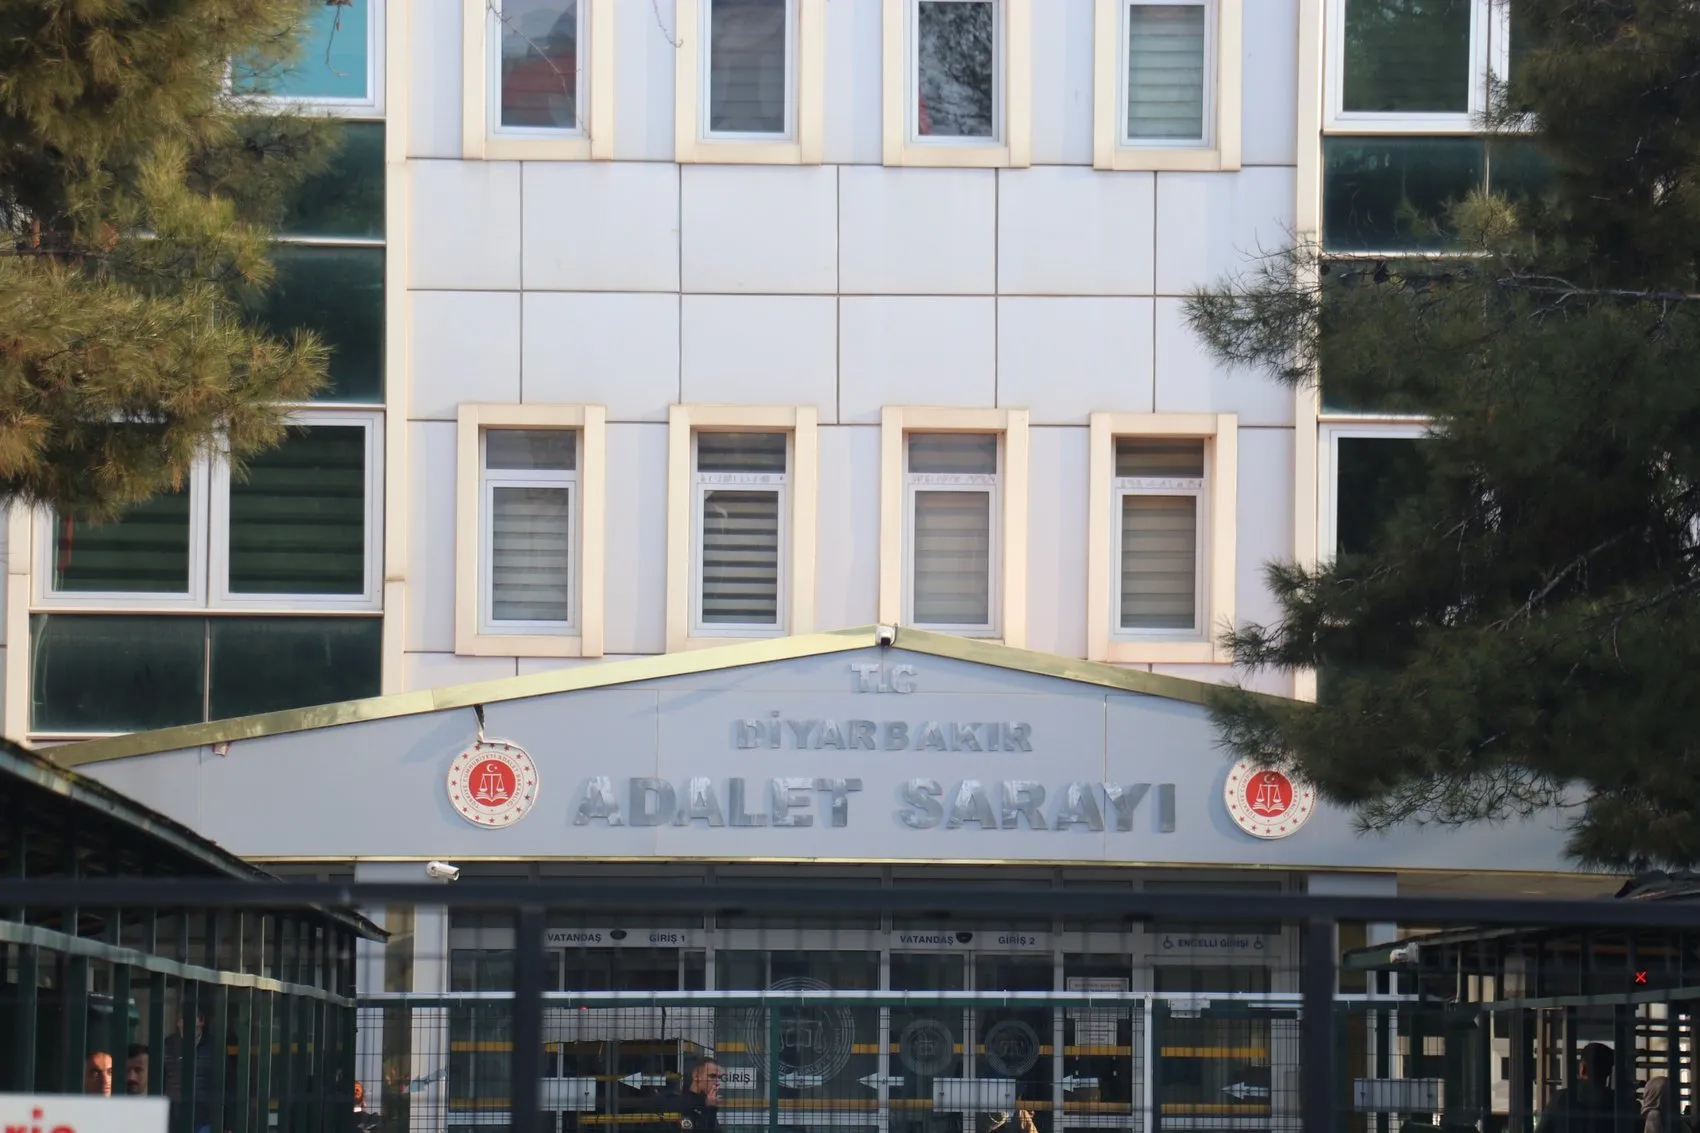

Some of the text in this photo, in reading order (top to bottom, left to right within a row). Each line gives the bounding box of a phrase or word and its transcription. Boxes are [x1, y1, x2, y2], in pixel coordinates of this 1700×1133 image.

[736, 710, 1034, 752] DİYARBAKIR
[572, 774, 862, 829] ADALET
[898, 776, 1177, 833] SARAYI
[547, 931, 686, 943] VATANDAŞ GİRİŞ 1
[900, 933, 1036, 945] VATANDAŞ GİRİŞ 2
[720, 1072, 751, 1084] GİRİŞ
